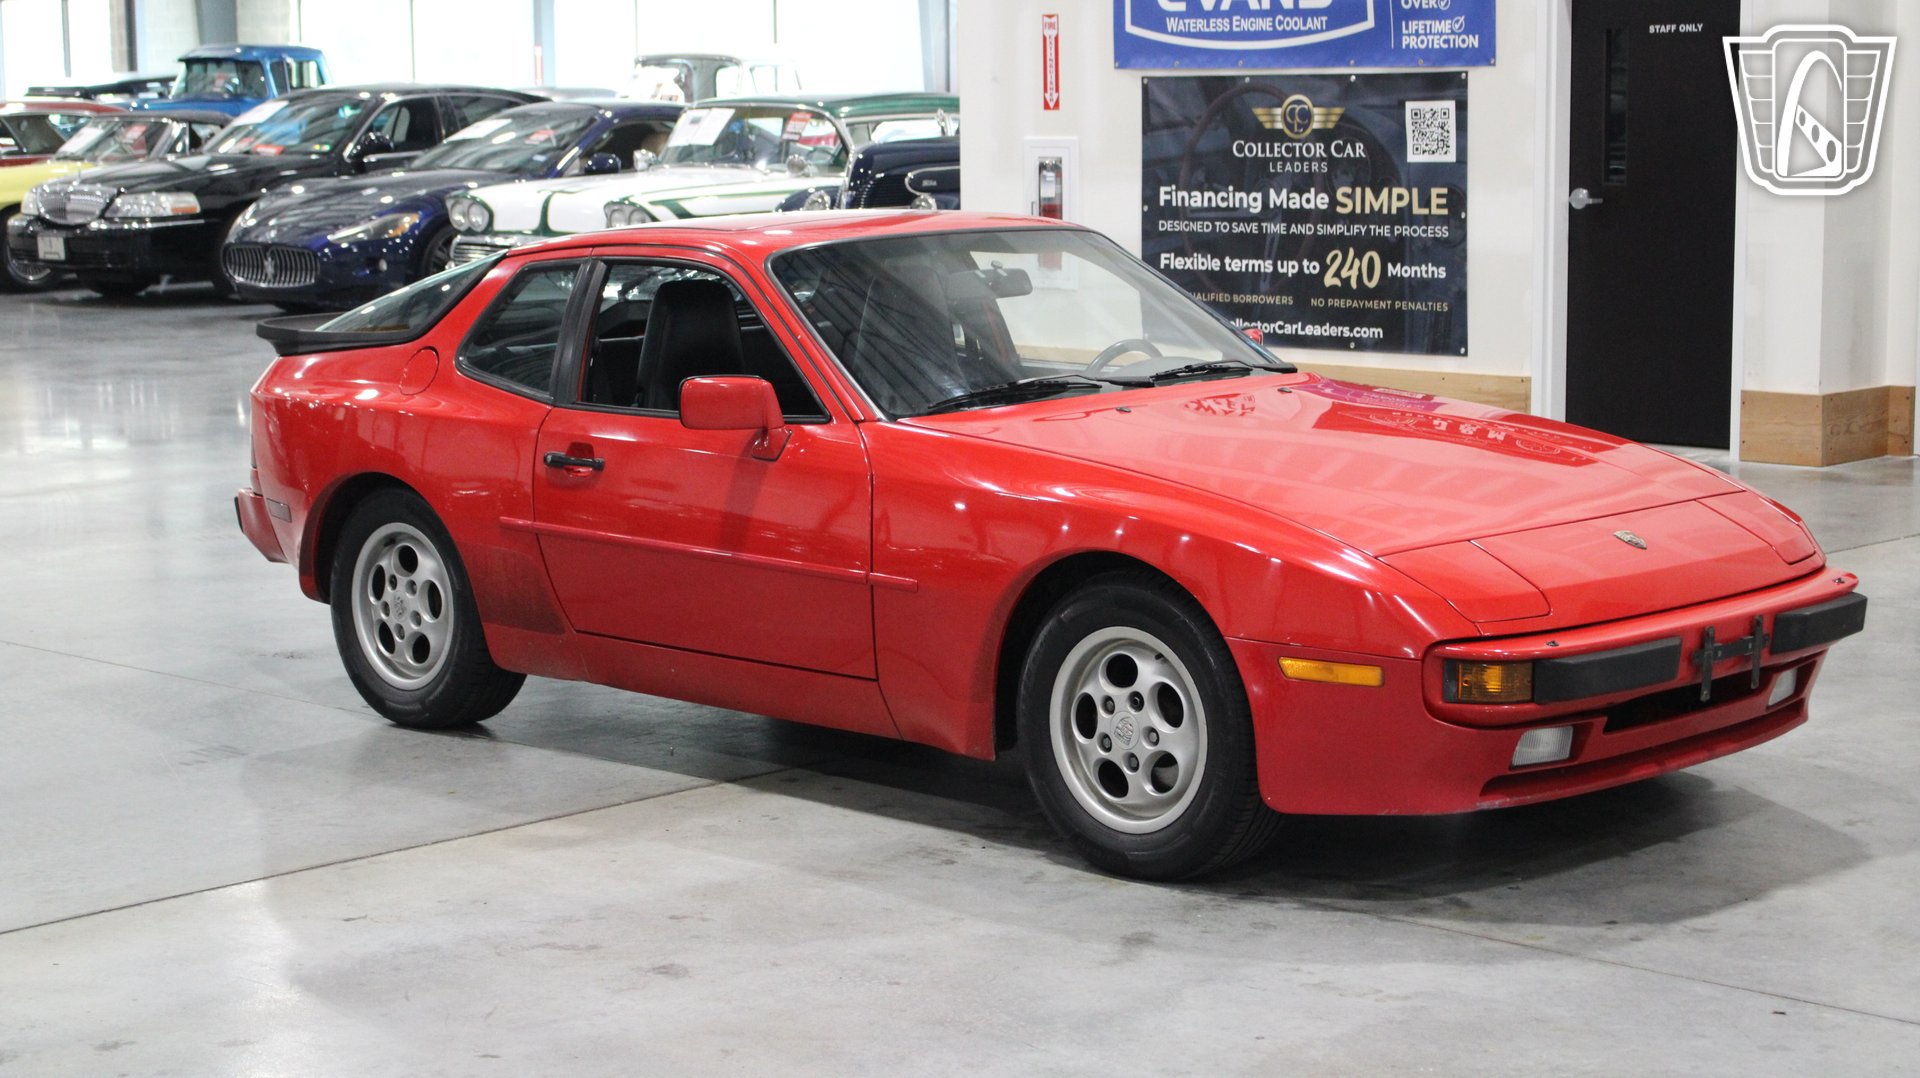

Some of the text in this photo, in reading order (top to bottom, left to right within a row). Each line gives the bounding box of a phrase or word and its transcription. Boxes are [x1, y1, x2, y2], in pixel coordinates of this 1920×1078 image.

[1166, 14, 1328, 33] WATERLESS ENGINE COOLANT
[1401, 20, 1452, 34] LIFETIME
[1649, 23, 1703, 34] STAFF ONLY
[1401, 34, 1479, 49] PROTECTION
[1232, 140, 1366, 158] COLLECTOR CAR
[1269, 161, 1328, 173] LEADERS
[1159, 184, 1449, 215] Financing Made SIMPLE
[1158, 220, 1449, 238] DESIGNED TO SAVE TIME AND SIMPLIFY THE PROCESS
[1160, 247, 1447, 290] Flexible terms up to 240 Months
[1233, 294, 1294, 306] BORROWERS
[1311, 298, 1449, 312] NO PREPAYMENT PENALTIES
